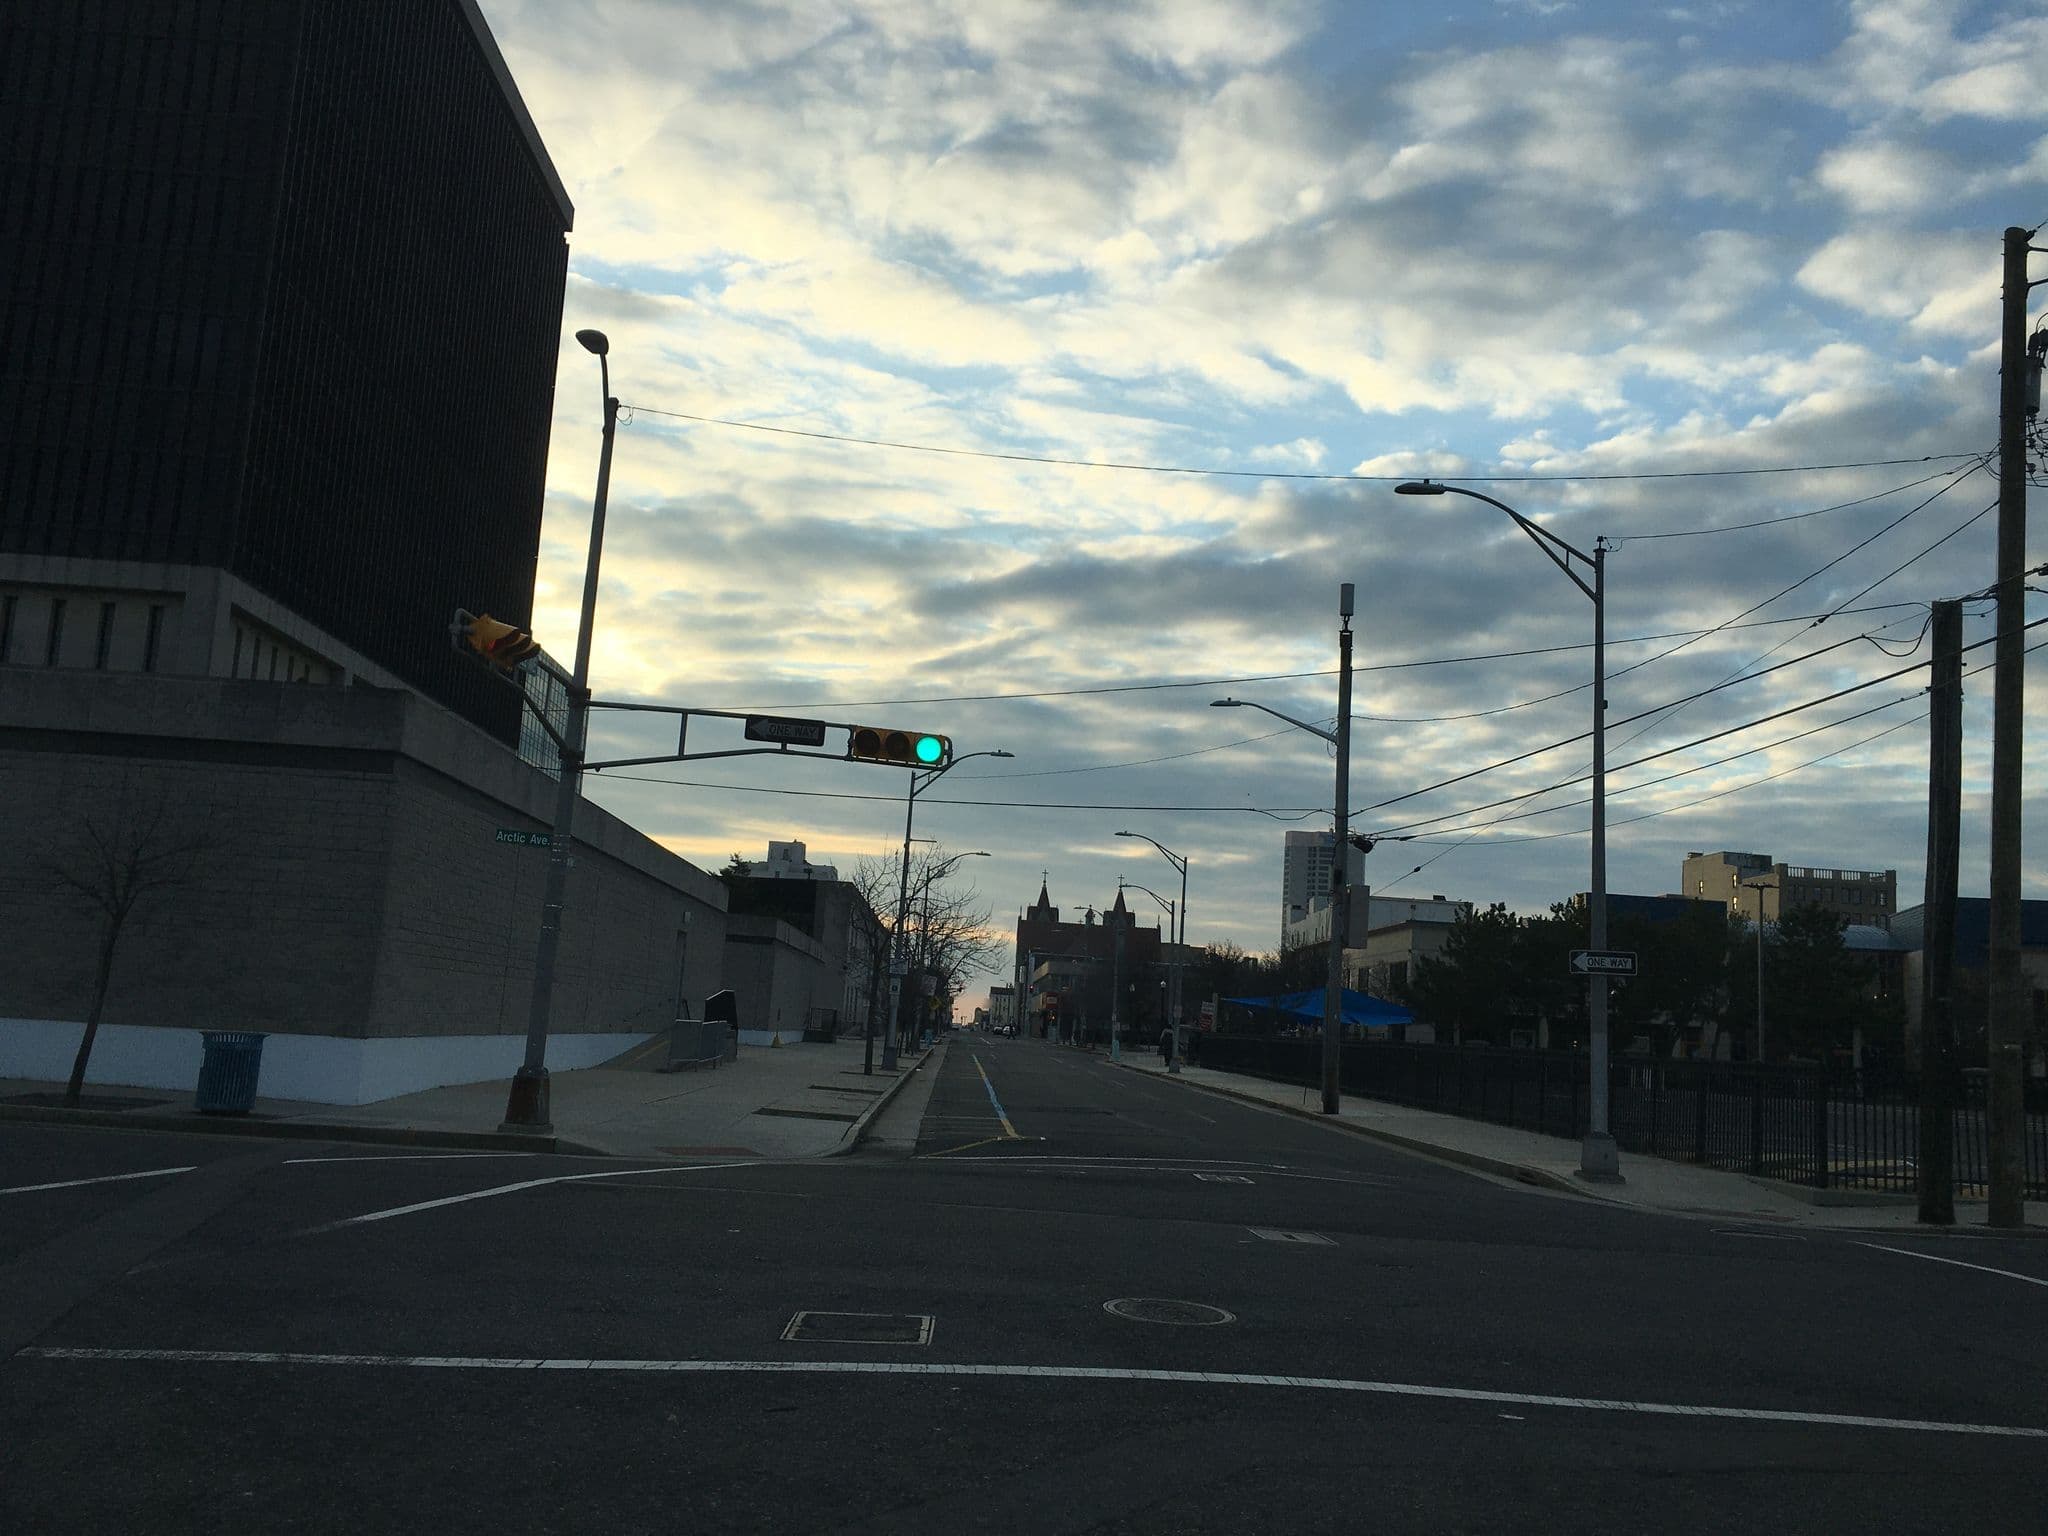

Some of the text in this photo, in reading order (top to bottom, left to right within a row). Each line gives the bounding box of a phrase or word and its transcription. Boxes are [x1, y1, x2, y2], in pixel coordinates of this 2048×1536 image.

[769, 724, 817, 738] ONE WAY
[496, 830, 526, 843] Arctic
[1587, 957, 1628, 967] ONE WAY
